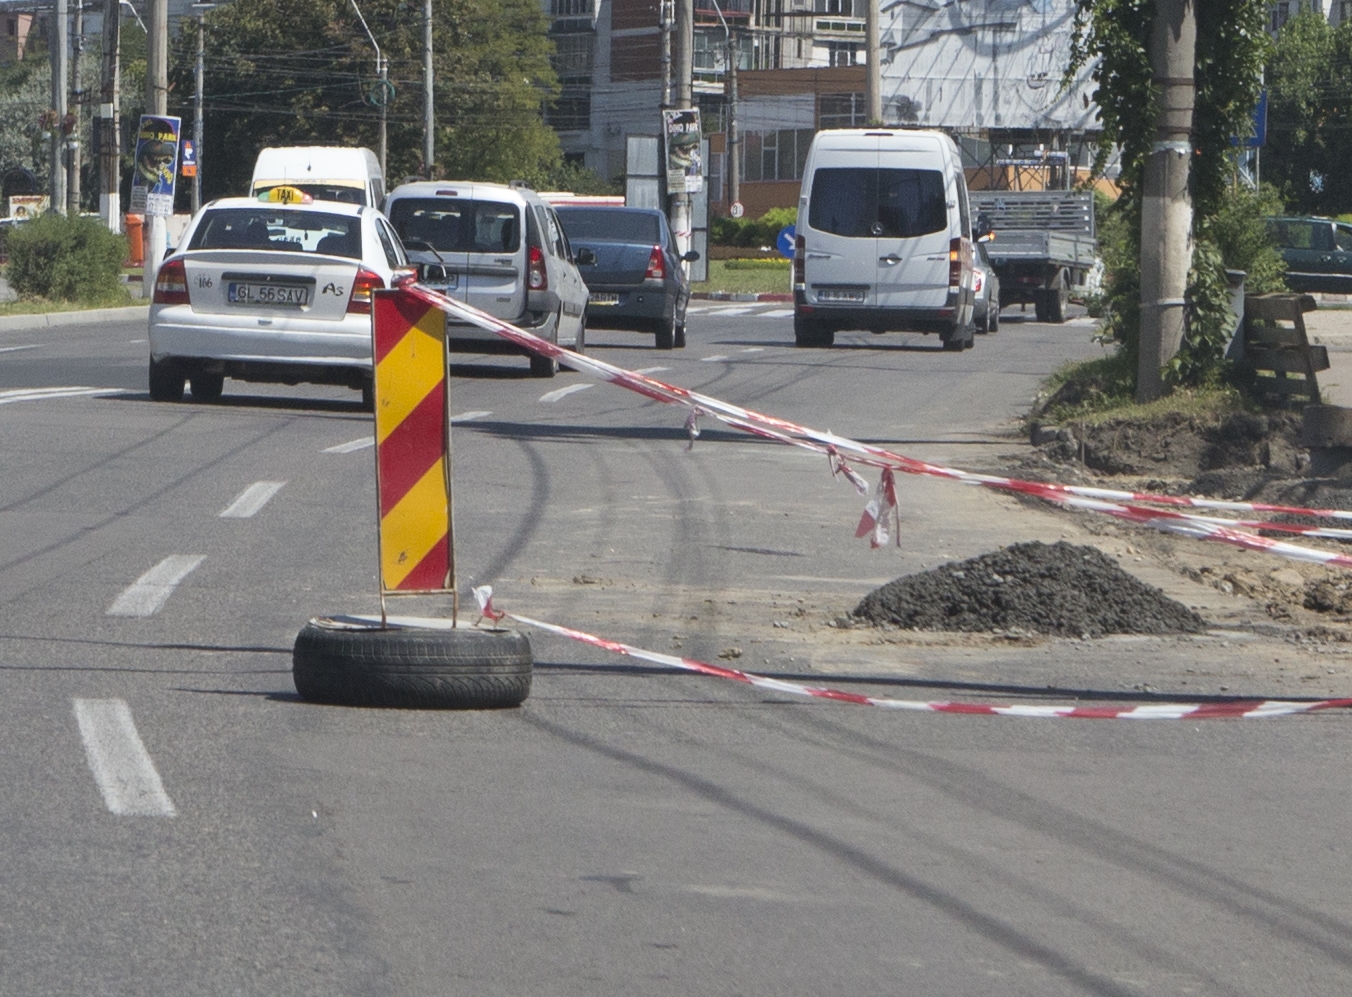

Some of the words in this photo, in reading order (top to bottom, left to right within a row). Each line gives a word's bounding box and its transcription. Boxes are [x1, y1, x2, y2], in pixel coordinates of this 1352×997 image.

[277, 189, 294, 201] TAXI
[237, 285, 254, 299] GL
[259, 287, 275, 301] 56
